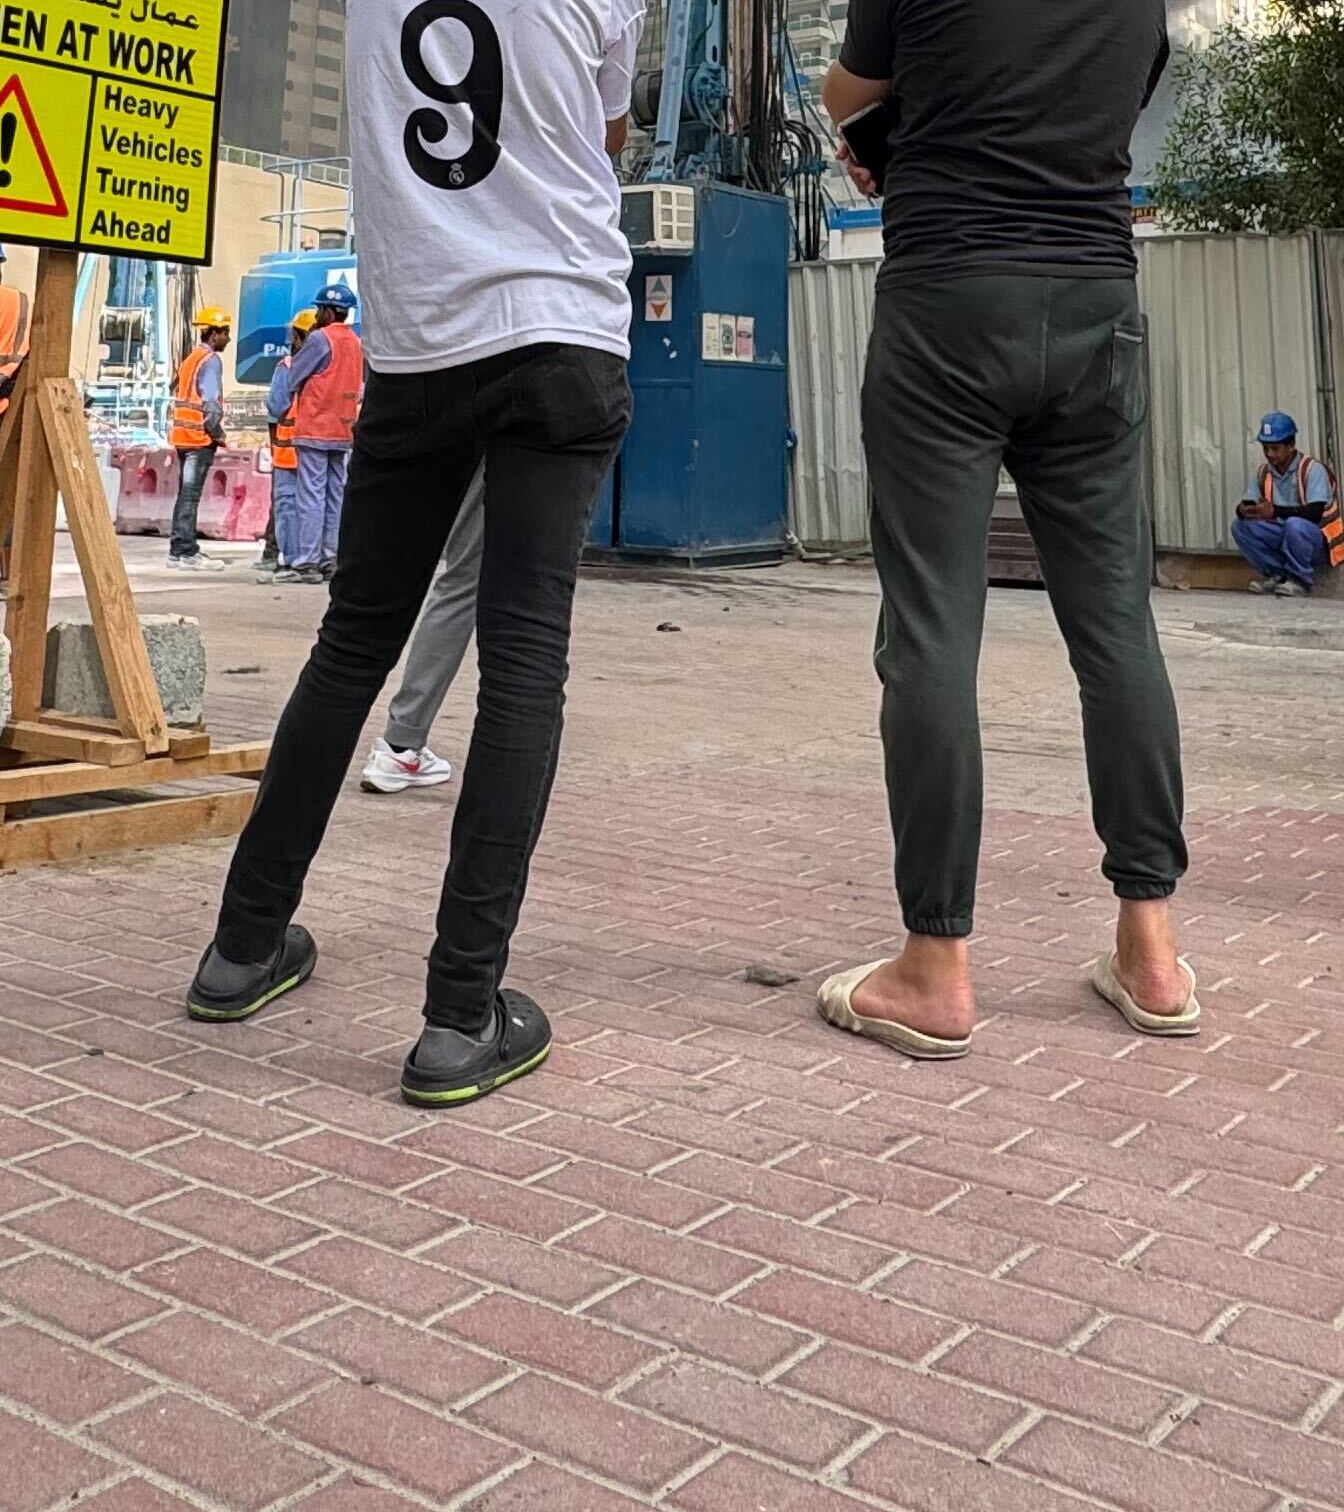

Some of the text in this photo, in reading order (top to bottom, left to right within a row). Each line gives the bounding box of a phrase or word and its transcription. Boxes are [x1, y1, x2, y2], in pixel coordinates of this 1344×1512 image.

[56, 18, 99, 62] AT
[108, 28, 197, 85] WORK
[103, 85, 180, 126] Heavy
[99, 124, 204, 168] Vehicles
[95, 167, 191, 213] Turning
[89, 208, 172, 245] Ahead
